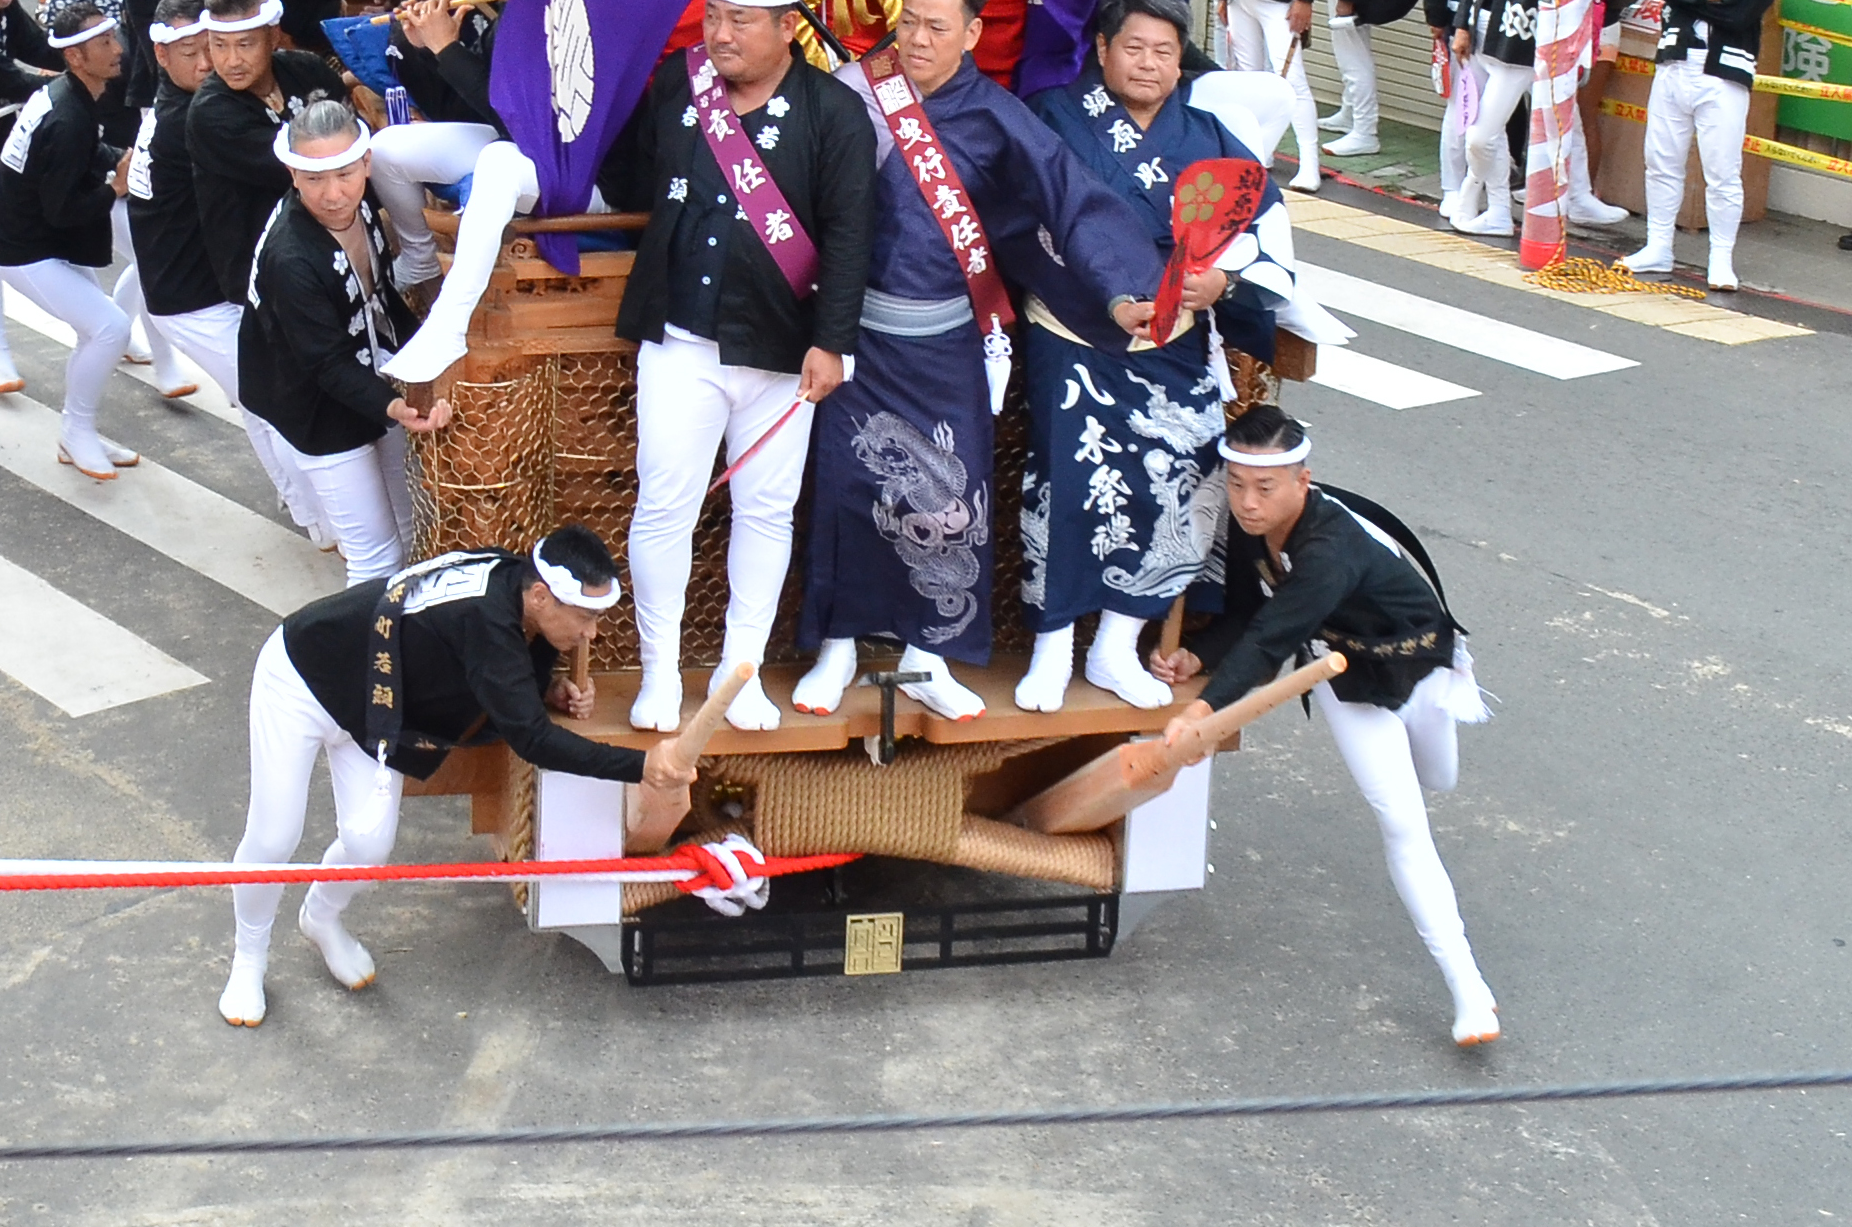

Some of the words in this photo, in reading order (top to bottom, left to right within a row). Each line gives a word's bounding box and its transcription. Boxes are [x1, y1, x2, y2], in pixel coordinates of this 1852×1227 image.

[707, 109, 794, 245] 責任者
[896, 116, 989, 279] 曳行責任者
